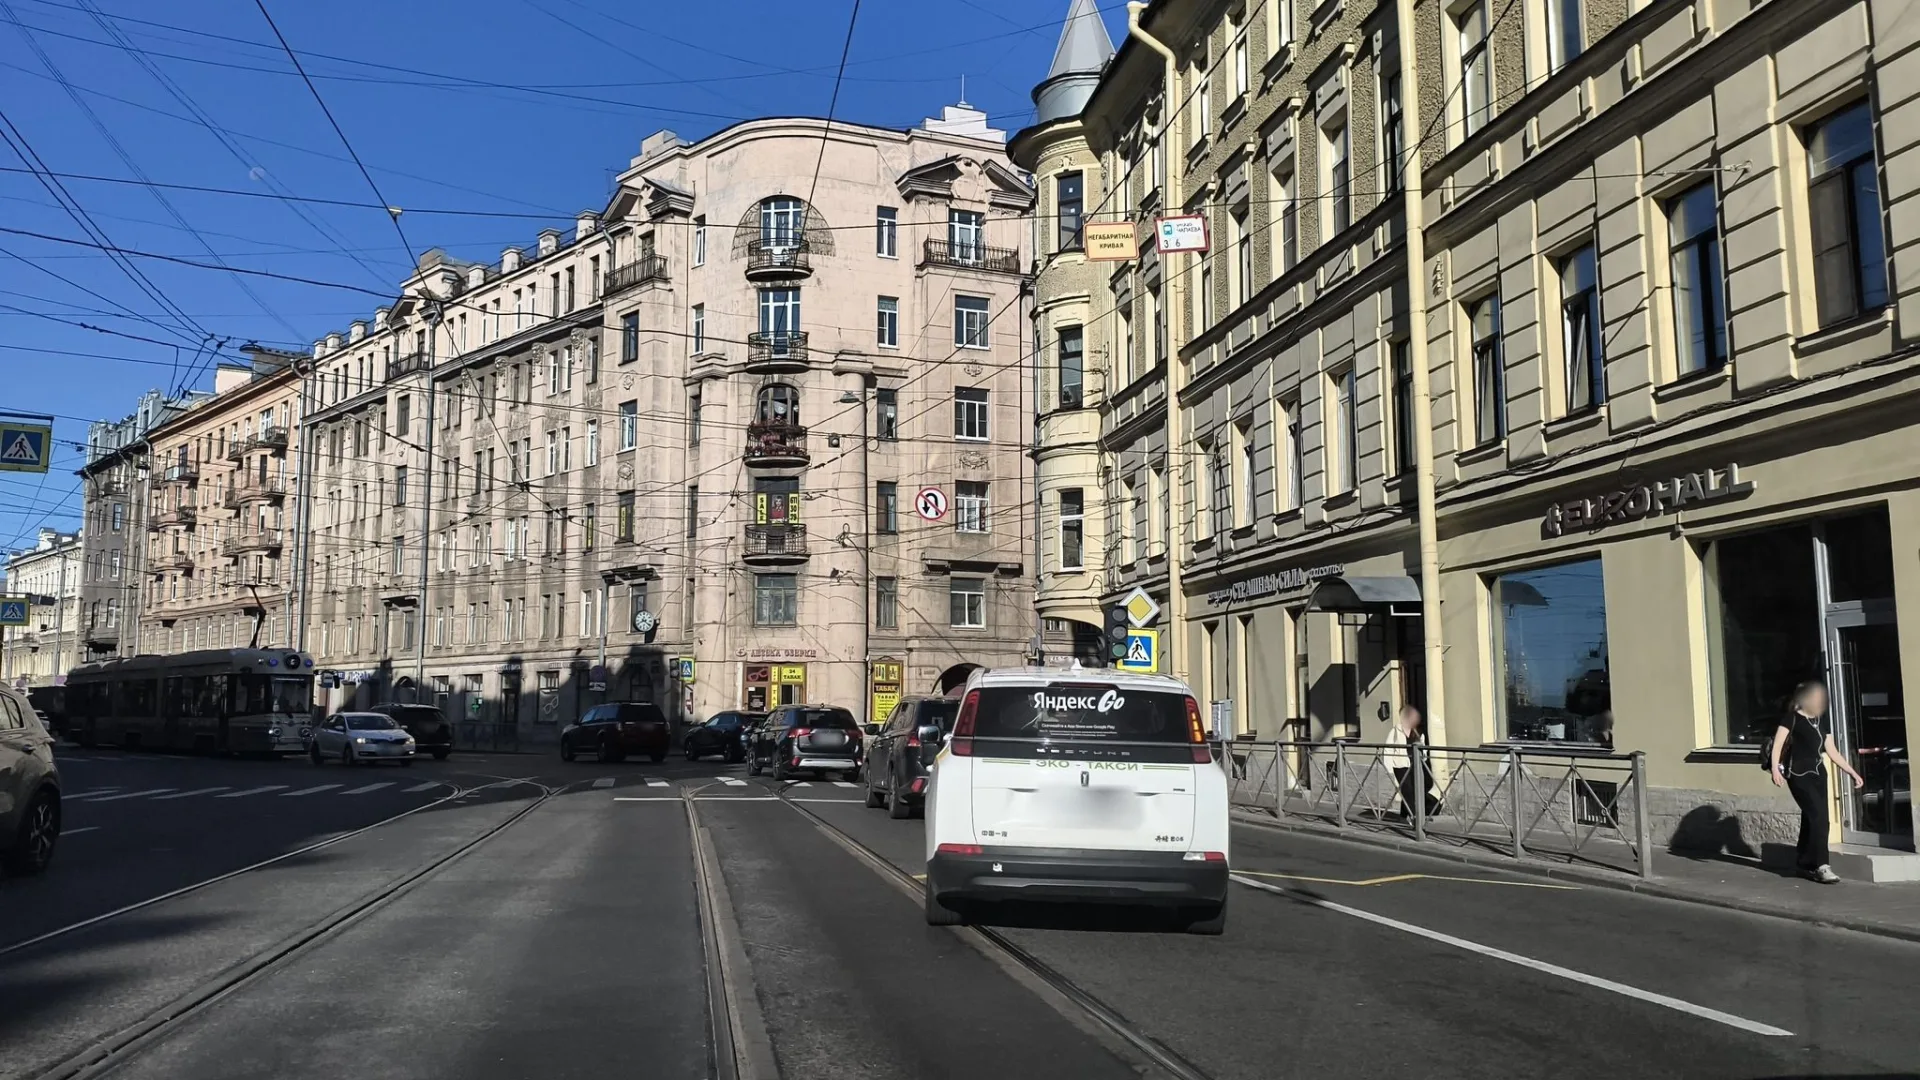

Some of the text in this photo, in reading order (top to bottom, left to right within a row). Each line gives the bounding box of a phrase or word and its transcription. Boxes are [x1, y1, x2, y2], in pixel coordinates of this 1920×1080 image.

[1164, 239, 1180, 248] 3 6
[1232, 573, 1276, 600] СТРАШНАЯ
[1278, 567, 1306, 589] СИЛА
[1033, 690, 1125, 712] Яндекс Go
[1036, 760, 1070, 768] ЭКО
[1088, 762, 1138, 771] ТАКСИ
